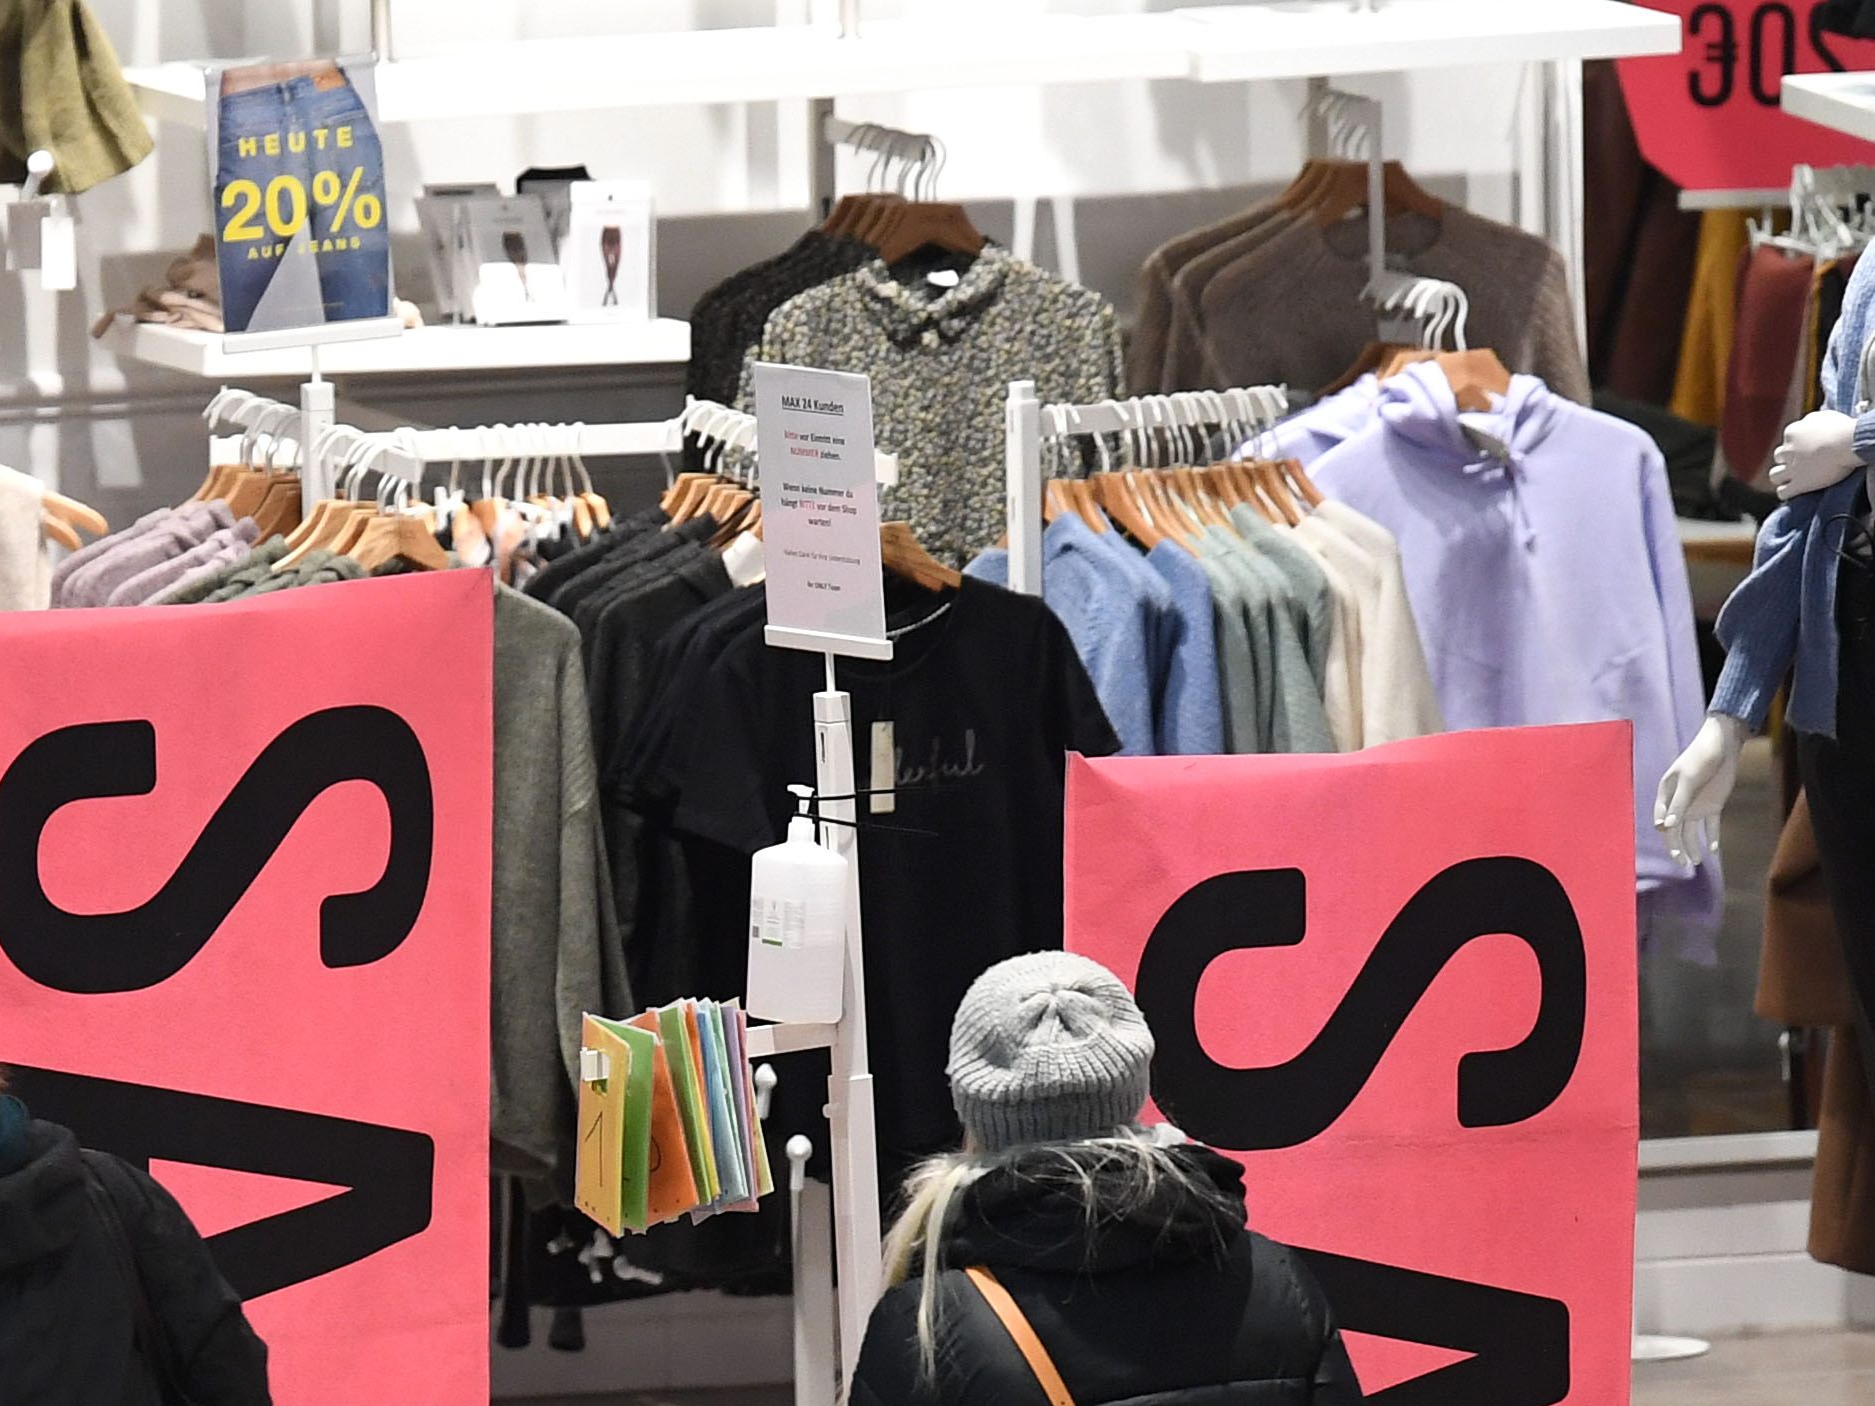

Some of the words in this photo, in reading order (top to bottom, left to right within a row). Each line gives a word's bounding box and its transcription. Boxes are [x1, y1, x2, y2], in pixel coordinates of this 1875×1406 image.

[238, 126, 354, 158] HEUTE
[221, 166, 382, 242] 20%
[248, 243, 285, 260] AUF
[782, 395, 801, 408] MAX
[802, 398, 813, 409] 24
[813, 400, 844, 413] Kunden
